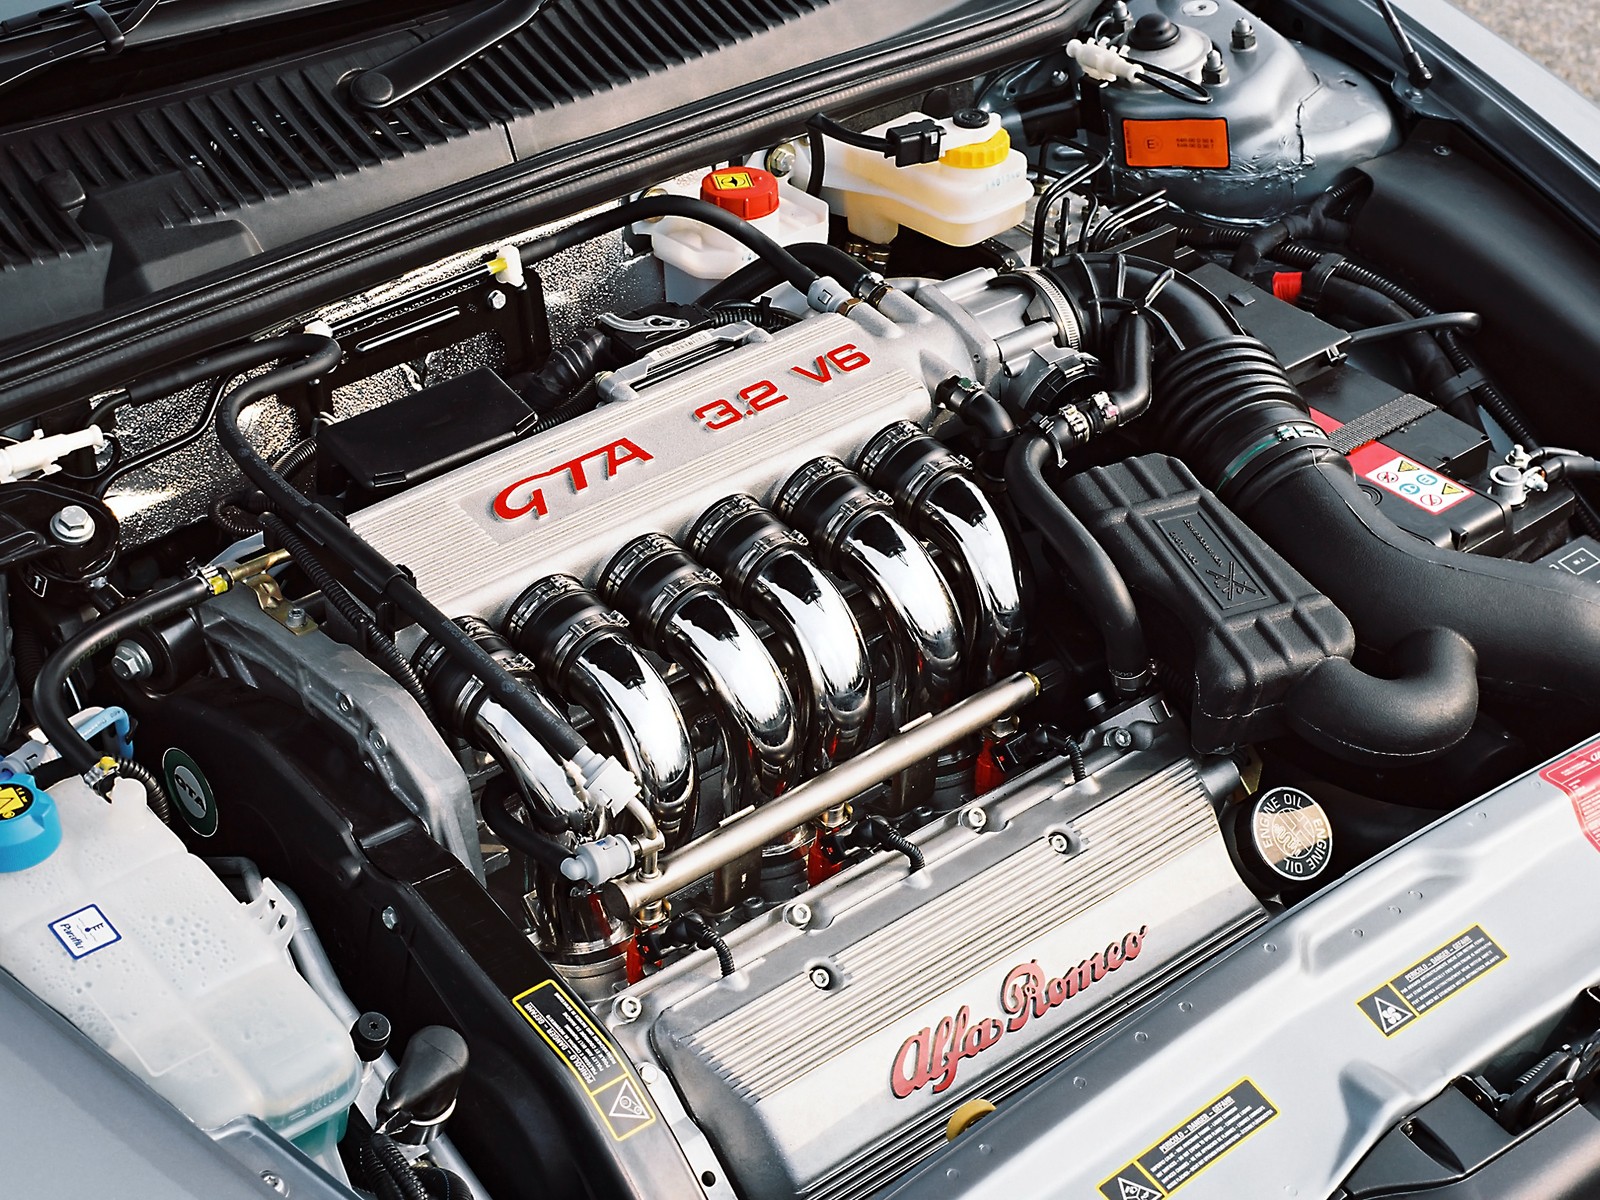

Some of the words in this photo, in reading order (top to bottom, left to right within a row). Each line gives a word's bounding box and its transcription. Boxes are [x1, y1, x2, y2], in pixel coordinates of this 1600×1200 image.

[493, 437, 654, 520] GTA
[694, 380, 790, 432] 3.2
[790, 343, 872, 384] V6
[175, 773, 206, 813] GTA
[1259, 796, 1281, 849] ENGINE
[1283, 793, 1303, 809] OIL
[1306, 819, 1327, 871] ENGINE
[1283, 857, 1303, 874] OIL
[523, 1001, 546, 1025] GEFAHR
[889, 1005, 1004, 1099] Alfa
[1000, 925, 1149, 1032] Romeo
[545, 1027, 569, 1050] DANGER
[566, 1053, 596, 1084] PERICOLO
[1186, 1112, 1210, 1132] DANGER
